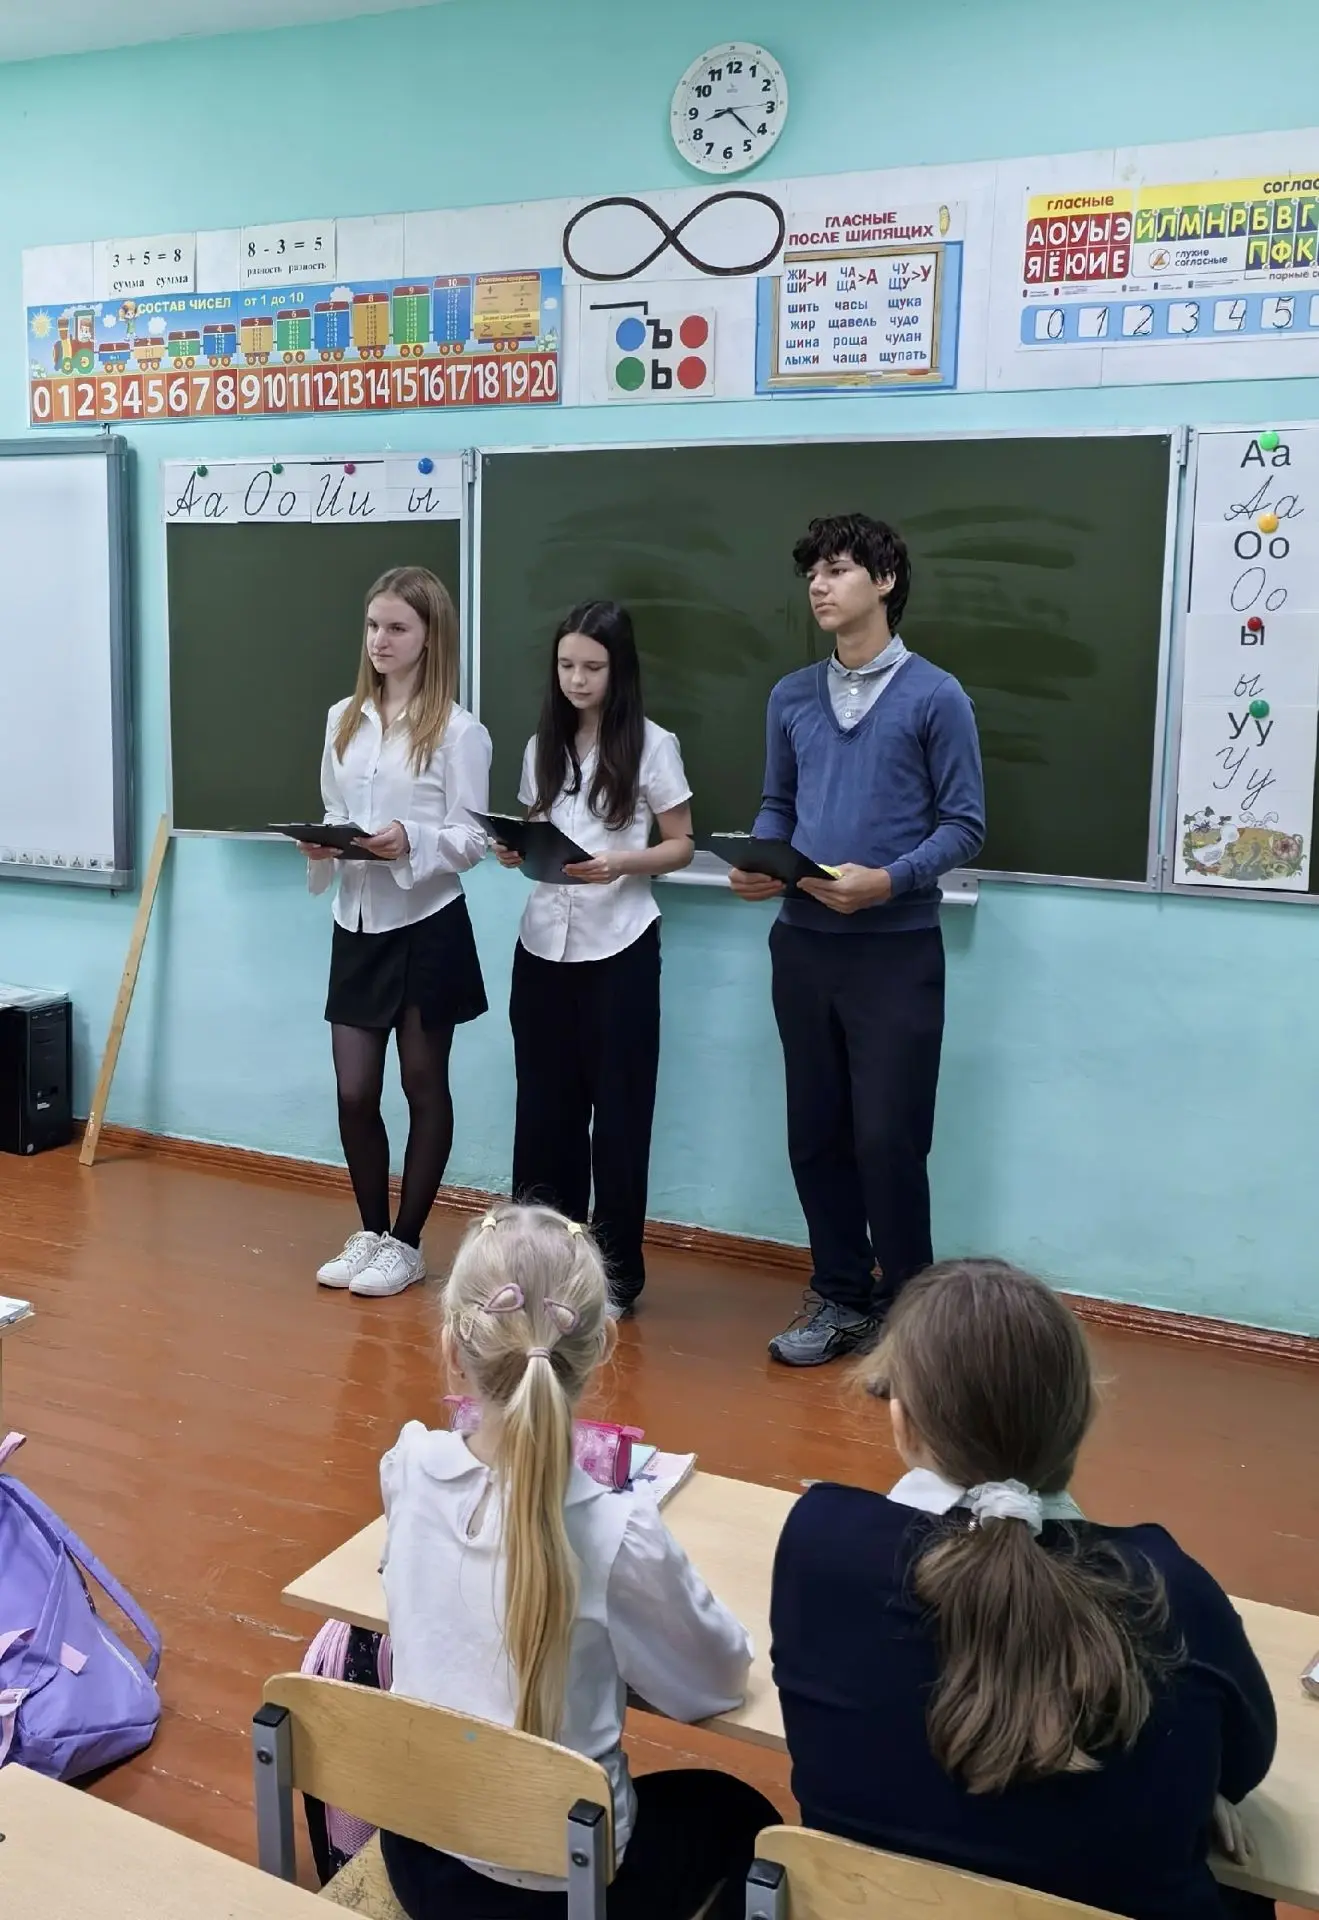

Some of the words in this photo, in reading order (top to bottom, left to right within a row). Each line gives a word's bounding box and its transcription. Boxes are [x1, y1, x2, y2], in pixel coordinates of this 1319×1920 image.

[727, 61, 742, 74] 12
[749, 65, 756, 77] 1
[708, 69, 722, 81] 11
[695, 85, 712, 97] 10
[762, 79, 771, 91] 2
[766, 101, 775, 113] 3
[688, 108, 698, 120] 9
[693, 128, 703, 140] 8
[757, 123, 767, 135] 4
[706, 143, 714, 154] 7
[743, 140, 752, 152] 5
[723, 147, 733, 159] 6
[1048, 196, 1114, 210] гласные
[825, 212, 897, 228] ГЛАСНЫЕ
[1136, 212, 1154, 239] Й
[1158, 215, 1176, 238] Л
[1180, 214, 1200, 236] М
[1207, 210, 1224, 234] Н
[1232, 209, 1246, 232] Р
[1253, 208, 1268, 230] Б
[1277, 206, 1292, 229] В
[1302, 204, 1314, 227] Г
[789, 232, 840, 246] ПОСЛЕ
[846, 225, 933, 242] ШИПЯЩИХ
[1029, 224, 1044, 246] А
[1049, 223, 1066, 245] О
[1071, 221, 1087, 242] У
[1090, 219, 1109, 241] Ы
[1114, 218, 1130, 240] Э
[248, 242, 256, 257] 8
[277, 239, 285, 254] 3
[314, 237, 322, 251] 5
[1249, 241, 1267, 264] П
[1272, 240, 1292, 263] Ф
[1297, 238, 1314, 261] К
[113, 254, 120, 267] 3
[143, 252, 151, 265] 5
[174, 249, 182, 262] 8
[1175, 256, 1228, 267] согласные
[1176, 250, 1209, 260] глухие
[893, 263, 909, 274] ЧУ
[1027, 257, 1041, 278] Я
[1049, 252, 1059, 277] Ё
[1066, 253, 1085, 274] Ю
[1089, 252, 1106, 274] И
[1113, 251, 1125, 272] Е
[788, 270, 806, 280] ЖИ
[840, 267, 856, 278] ЧА
[1269, 271, 1309, 281] парные
[113, 279, 144, 292] сумма
[156, 275, 188, 288] сумма
[787, 282, 806, 293] ШИ
[837, 280, 856, 292] ЩА
[889, 278, 910, 291] ЩУ
[244, 297, 257, 306] от
[261, 295, 266, 305] 1
[271, 295, 285, 306] до
[290, 292, 304, 303] 10
[788, 302, 819, 314] шить
[835, 300, 867, 310] часы
[888, 297, 922, 310] щука
[138, 301, 185, 314] СОСТАВ
[190, 298, 230, 310] ЧИСЕЛ
[791, 319, 815, 331] жир
[829, 318, 876, 329] щавель
[890, 315, 919, 328] чудо
[1047, 309, 1064, 338] 0
[1097, 308, 1108, 336] 1
[1133, 305, 1154, 334] 2
[1183, 302, 1199, 333] 3
[1229, 300, 1246, 330] 4
[1273, 296, 1295, 328] 5
[786, 338, 819, 349] шина
[834, 336, 867, 349] роща
[886, 332, 922, 345] чулан
[785, 354, 819, 366] лыжи
[833, 352, 867, 364] чаща
[879, 350, 927, 363] щупать
[34, 387, 50, 417] 0
[58, 385, 70, 416] 1
[77, 384, 94, 416] 2
[100, 382, 118, 414] 3
[123, 381, 142, 414] 4
[148, 380, 164, 413] 5
[169, 378, 187, 411] 6
[192, 377, 210, 410] 7
[216, 376, 234, 410] 8
[241, 374, 260, 409] 9
[264, 373, 285, 408] 10
[289, 372, 311, 406] 11
[314, 371, 338, 406] 12
[340, 370, 364, 405] 13
[366, 368, 390, 404] 14
[392, 367, 417, 402] 15
[419, 365, 444, 401] 16
[446, 364, 472, 400] 17
[474, 362, 499, 398] 18
[502, 360, 527, 397] 19
[530, 360, 557, 397] 20
